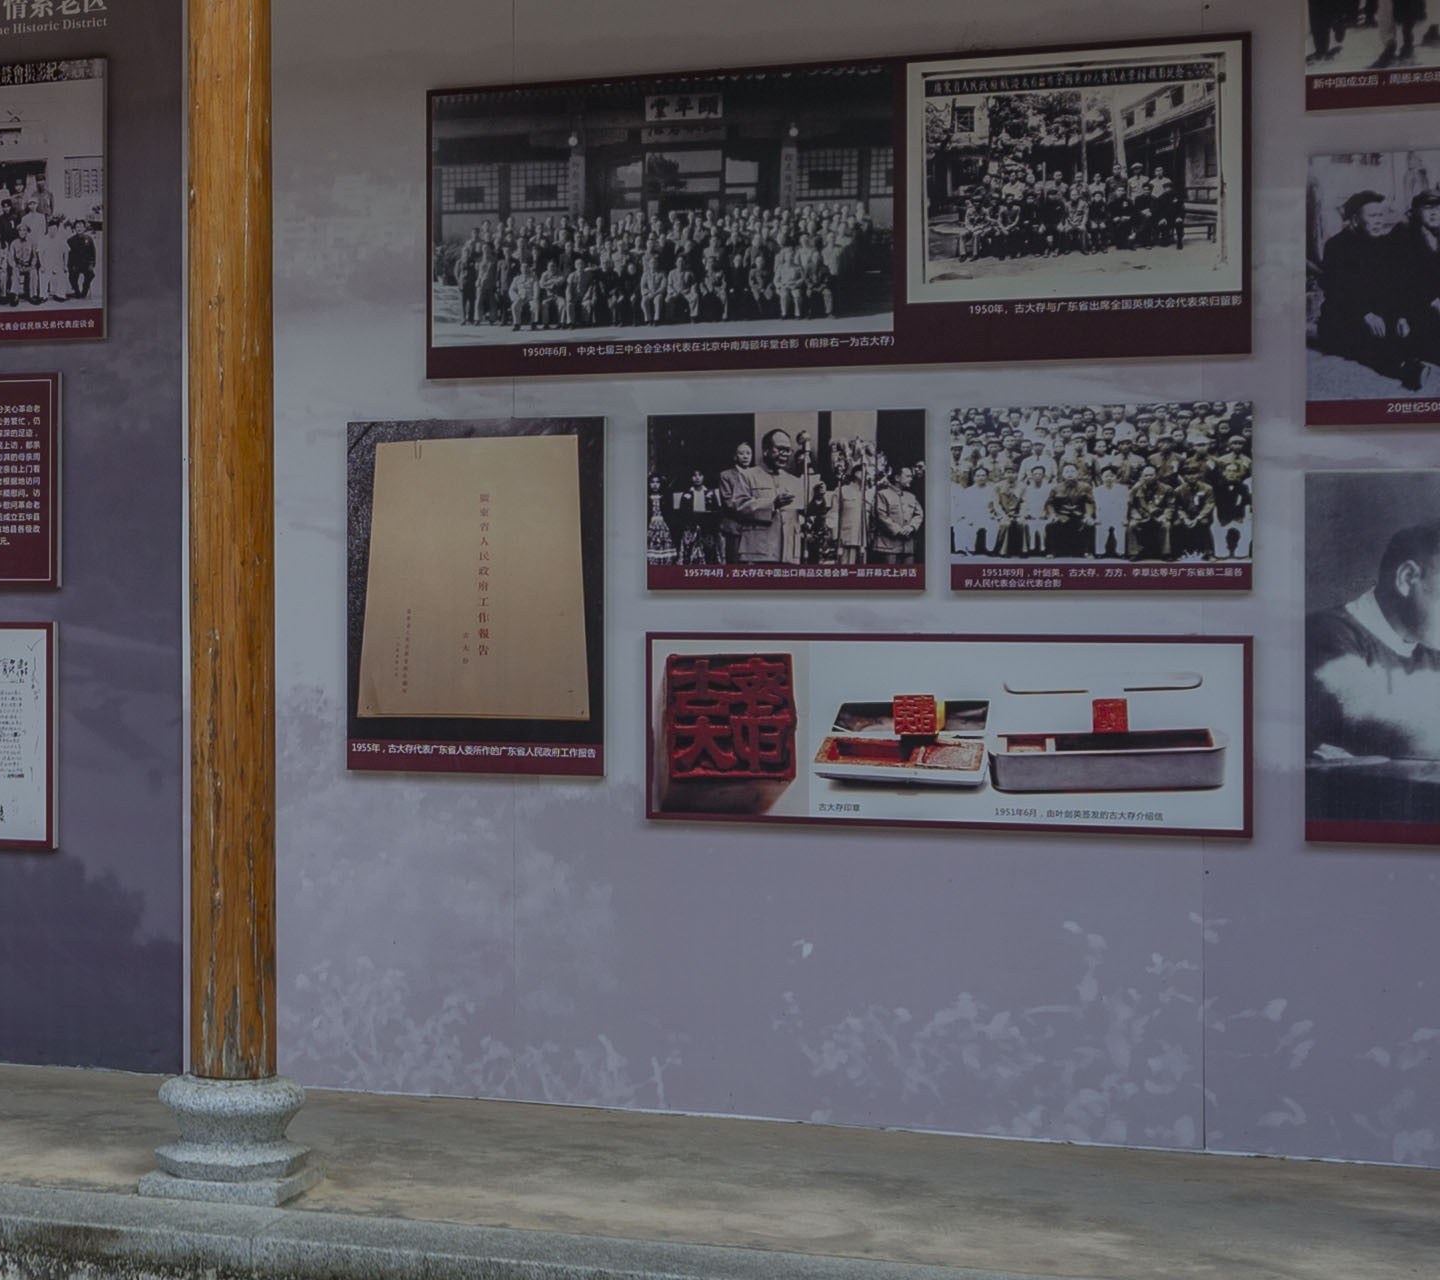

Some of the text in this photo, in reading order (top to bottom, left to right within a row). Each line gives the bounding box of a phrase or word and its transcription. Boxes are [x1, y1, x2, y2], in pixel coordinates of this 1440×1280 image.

[13, 20, 60, 34] Historic
[62, 16, 108, 31] District
[819, 802, 862, 814] 古大存印章
